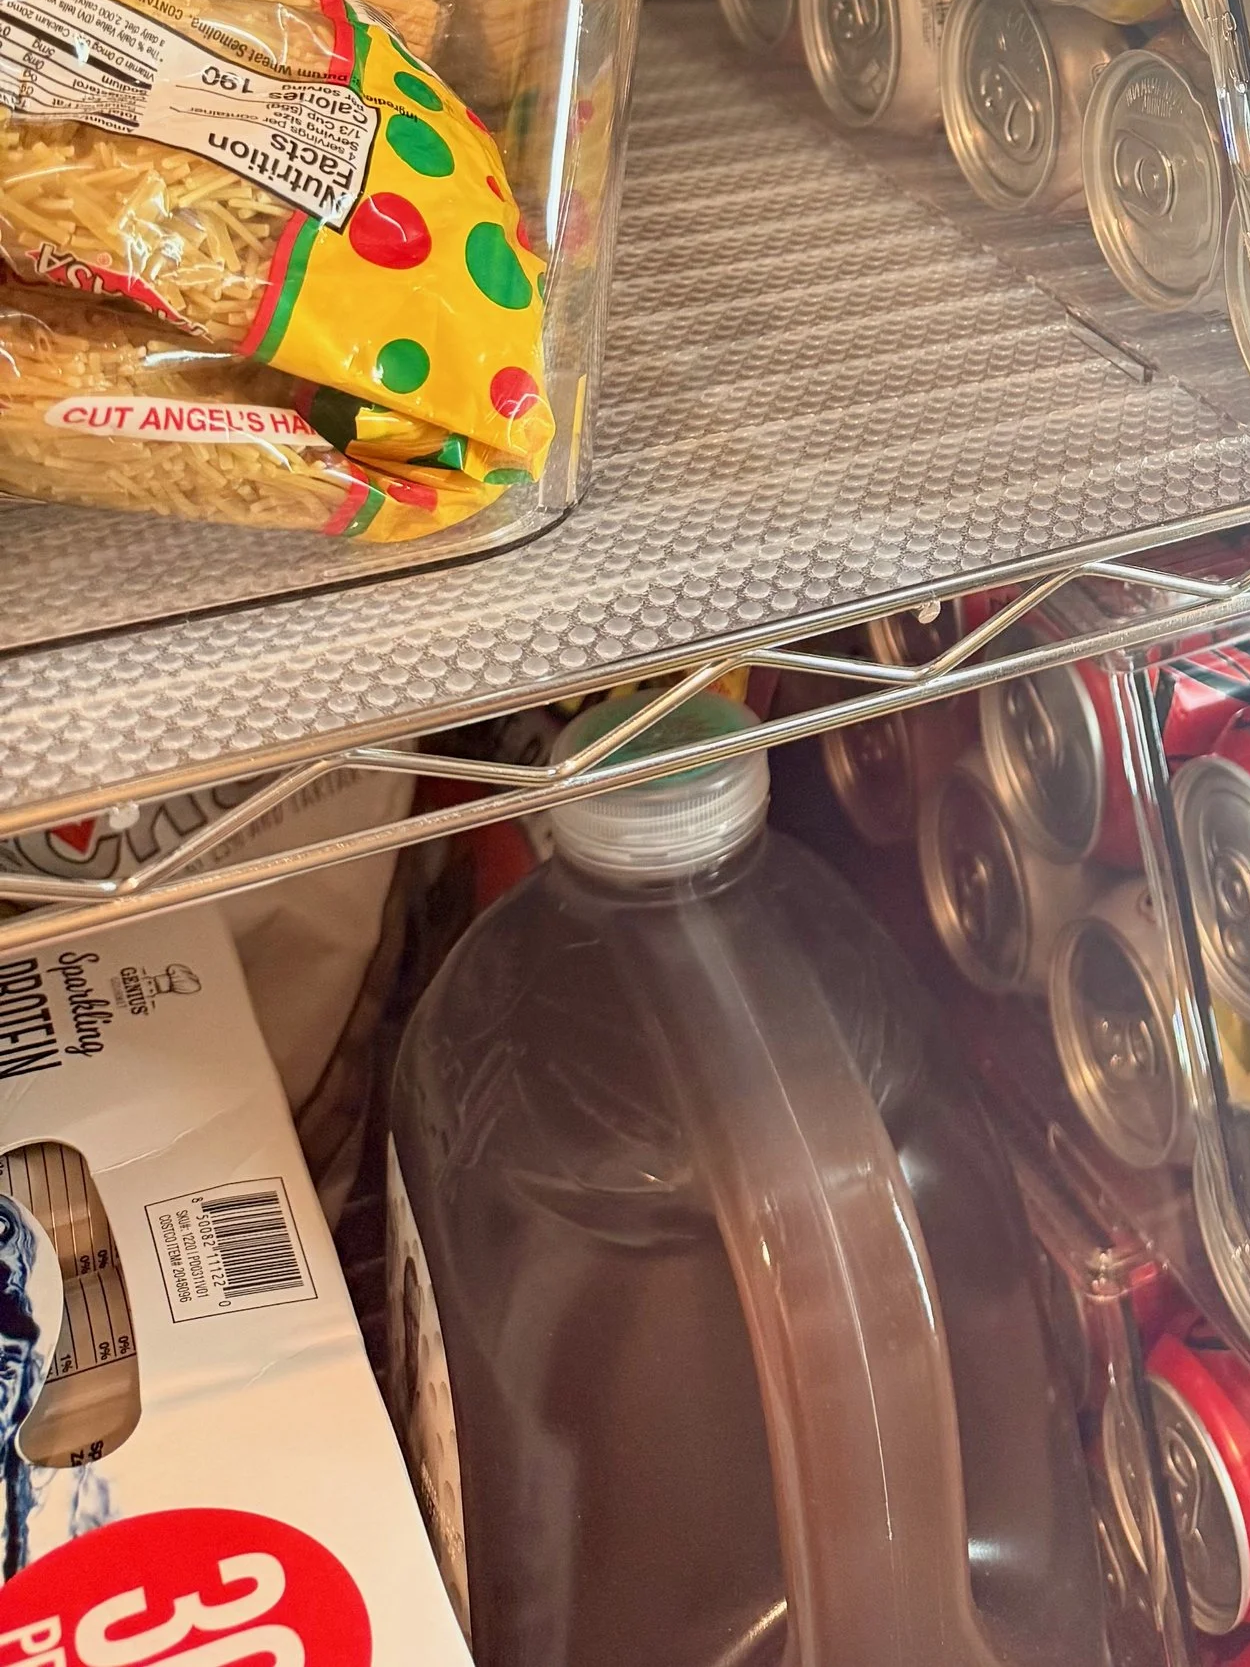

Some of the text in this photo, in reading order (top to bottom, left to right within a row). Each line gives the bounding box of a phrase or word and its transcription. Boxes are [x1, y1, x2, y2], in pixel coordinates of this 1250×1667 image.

[34, 10, 72, 37] Calcium
[74, 6, 95, 25] (DV)
[96, 5, 123, 27] 2,000
[93, 17, 118, 37] Value
[115, 28, 138, 48] Daily
[120, 19, 141, 36] diet.
[138, 26, 161, 46] daily
[184, 13, 247, 58] Semolina.
[30, 36, 57, 59] 5mg
[89, 40, 116, 61] 0mcg
[21, 51, 45, 71] 0mg
[114, 54, 125, 66] D
[123, 59, 156, 84] Vitamin
[199, 63, 366, 123] Calories 190
[262, 112, 287, 130] per
[272, 107, 358, 151] Serving size
[304, 108, 337, 131] Cup
[288, 122, 346, 157] servings
[338, 122, 362, 141] 1/3
[266, 132, 355, 187] Facts
[346, 151, 356, 162] 4
[204, 132, 344, 213] Nutrition
[63, 406, 134, 429] CUT
[139, 406, 268, 434] ANGEL'S
[119, 965, 147, 1015] GENIUS
[47, 950, 115, 1057] Sparkling
[0, 956, 63, 1080] PROTEIN
[175, 1209, 191, 1231] SKU#:
[181, 1231, 197, 1250] 1220
[190, 1196, 202, 1204] 8
[196, 1213, 215, 1247] 50082
[206, 1252, 225, 1287] 11122
[78, 1255, 91, 1274] 0%
[97, 1249, 109, 1268] 0%
[158, 1214, 192, 1302] COSTCO ITEM# 2048096
[98, 1341, 111, 1360] 0%
[117, 1335, 130, 1354] 0%
[59, 1353, 72, 1373] 1%
